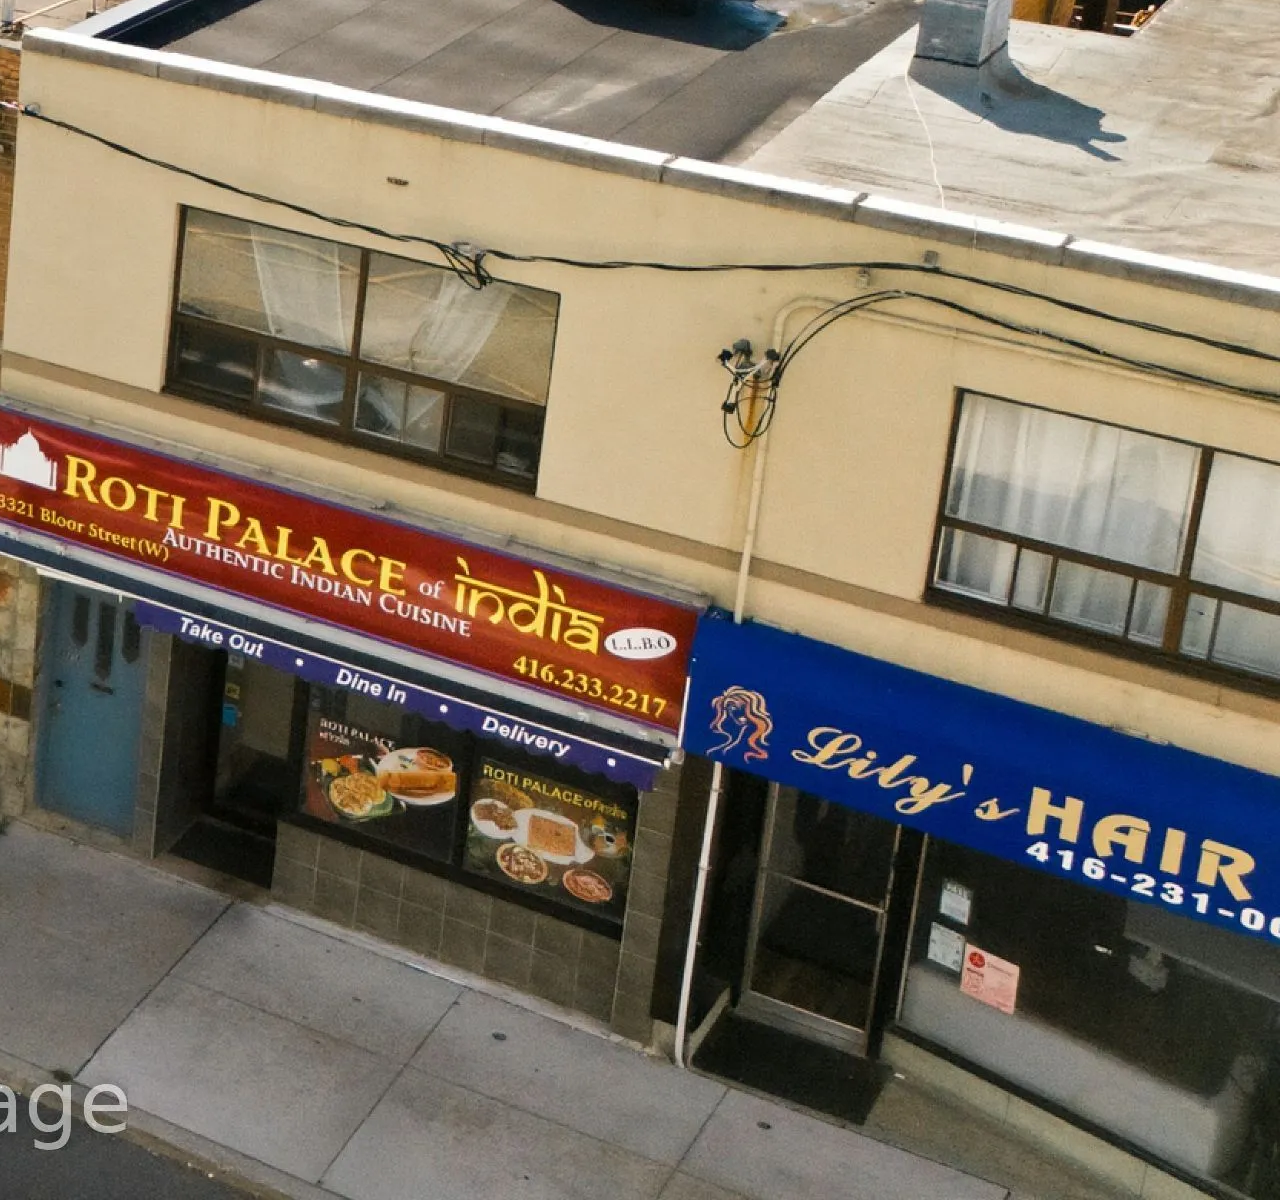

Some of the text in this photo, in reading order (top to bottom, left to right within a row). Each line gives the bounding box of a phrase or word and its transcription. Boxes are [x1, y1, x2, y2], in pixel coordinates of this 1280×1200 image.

[40, 508, 85, 534] Bloor
[62, 454, 605, 657] ROTI PALACE of india
[162, 527, 473, 638] AUTHENTIC INDIAN CUISINE
[180, 616, 265, 659] Take Out
[335, 667, 407, 705] Dine In
[512, 655, 668, 720] 416.233.2217
[481, 714, 572, 758] Delivery
[483, 763, 519, 786] ROTI
[522, 777, 583, 807] PALACE
[790, 726, 1257, 903] Lily's HAIR
